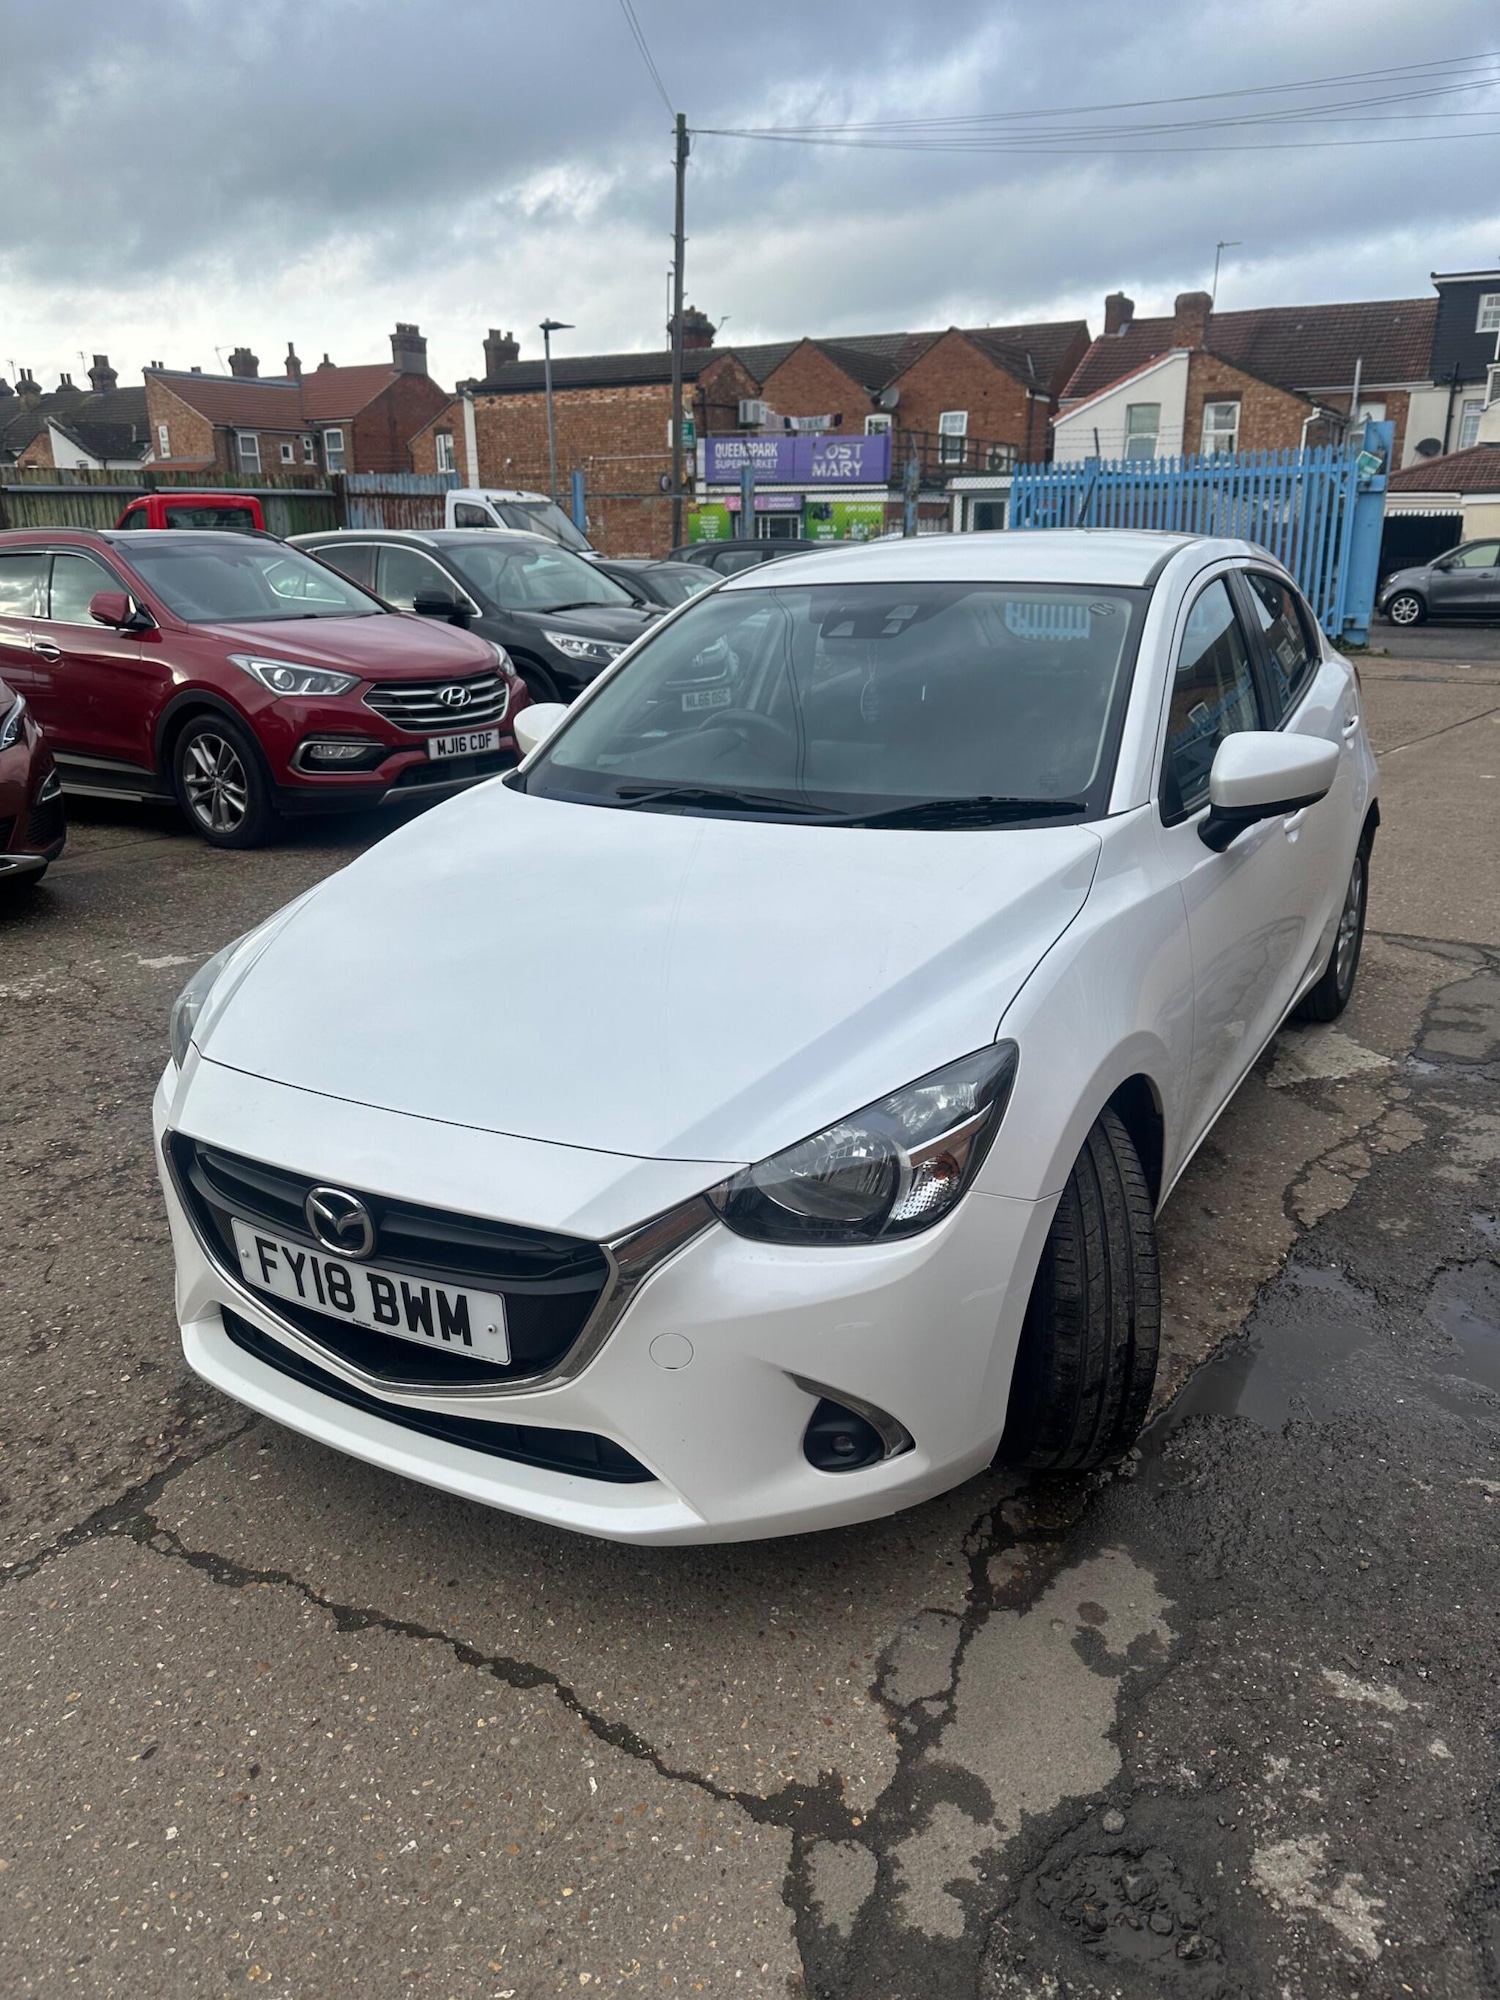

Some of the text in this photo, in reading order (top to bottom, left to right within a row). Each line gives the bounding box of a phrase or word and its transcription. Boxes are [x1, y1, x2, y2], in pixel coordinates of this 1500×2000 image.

[812, 442, 864, 459] LOST
[812, 461, 863, 477] MARY
[437, 732, 492, 756] MJ16 CDF
[254, 1235, 473, 1347] FY18 BWM
